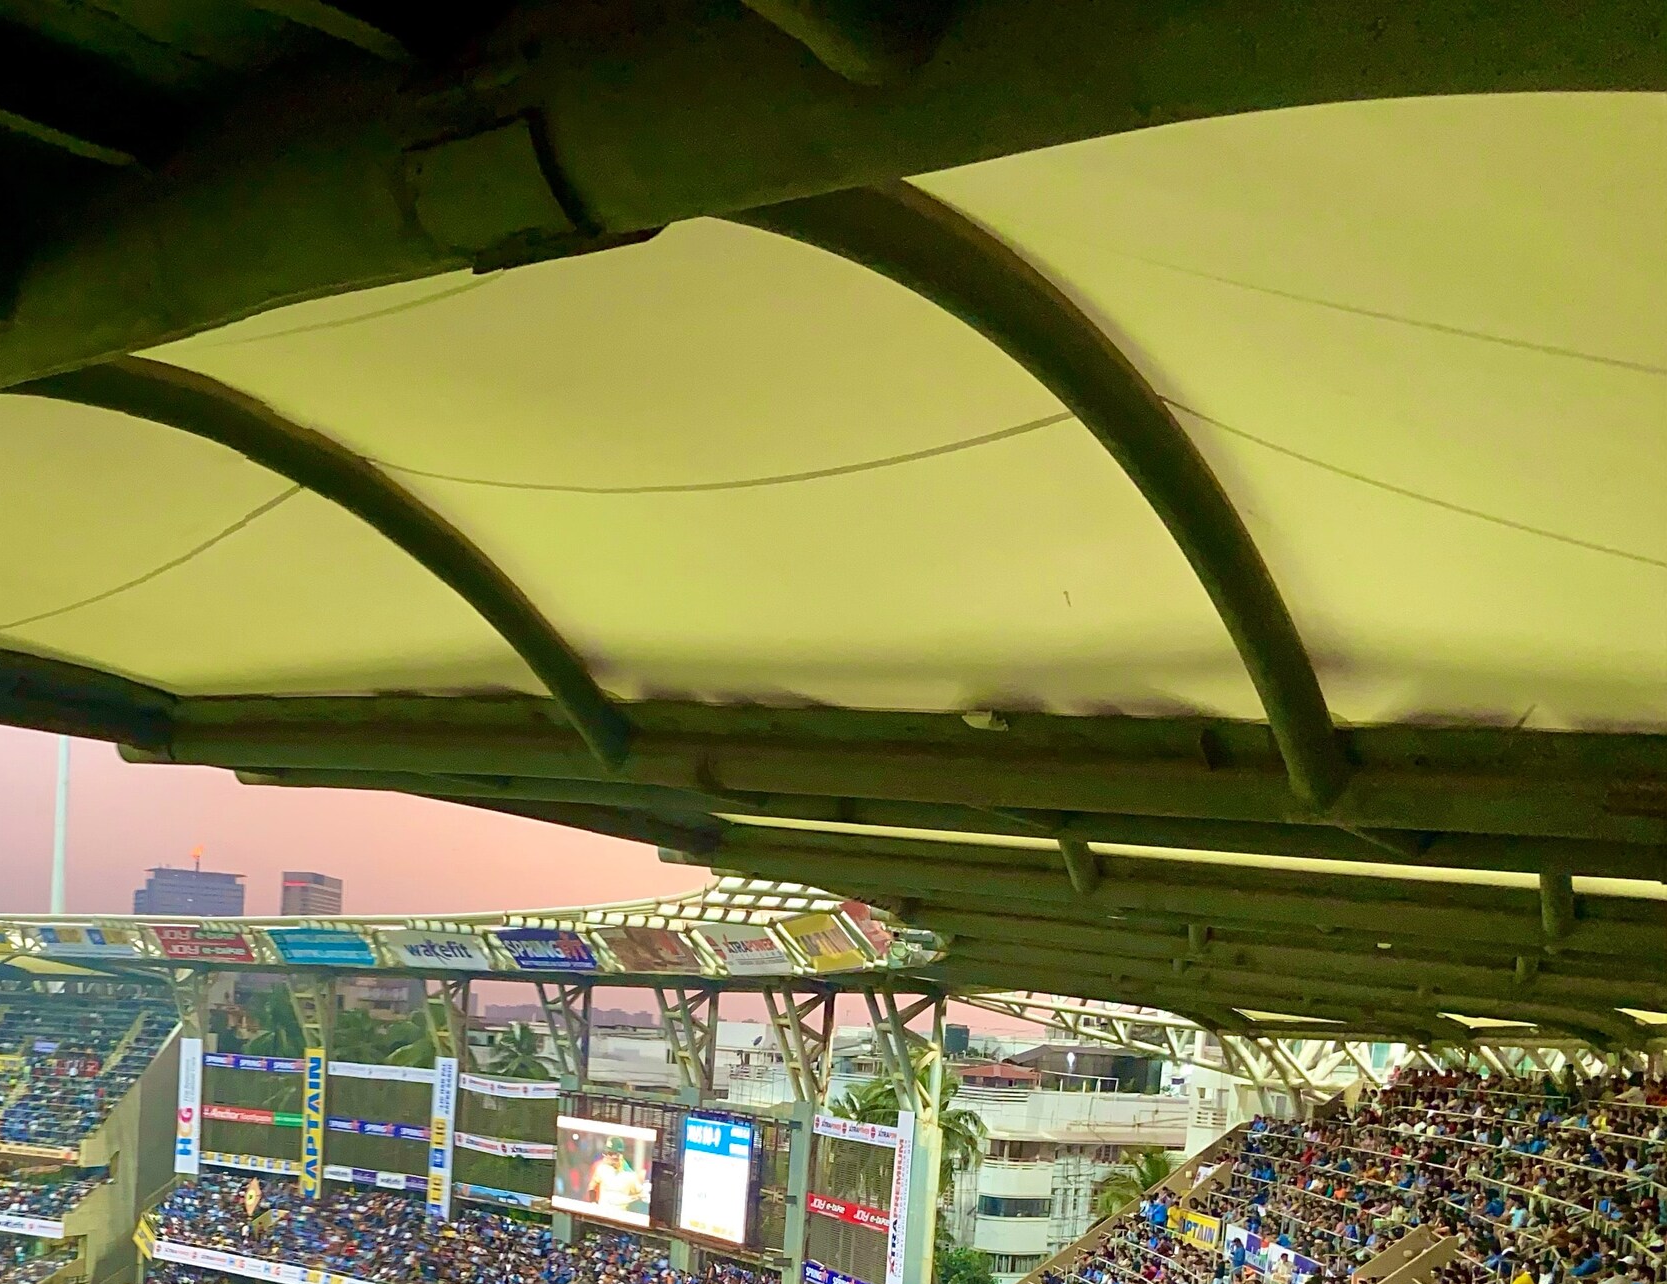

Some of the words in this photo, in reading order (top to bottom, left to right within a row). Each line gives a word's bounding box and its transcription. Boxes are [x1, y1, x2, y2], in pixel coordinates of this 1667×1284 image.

[403, 937, 473, 966] wakefit
[177, 1107, 193, 1156] HCG
[303, 1055, 323, 1199] CAPTAIN
[810, 1198, 825, 1211] JOY
[853, 1209, 869, 1223] JOY
[889, 1138, 905, 1274] XTRAPREMIUM
